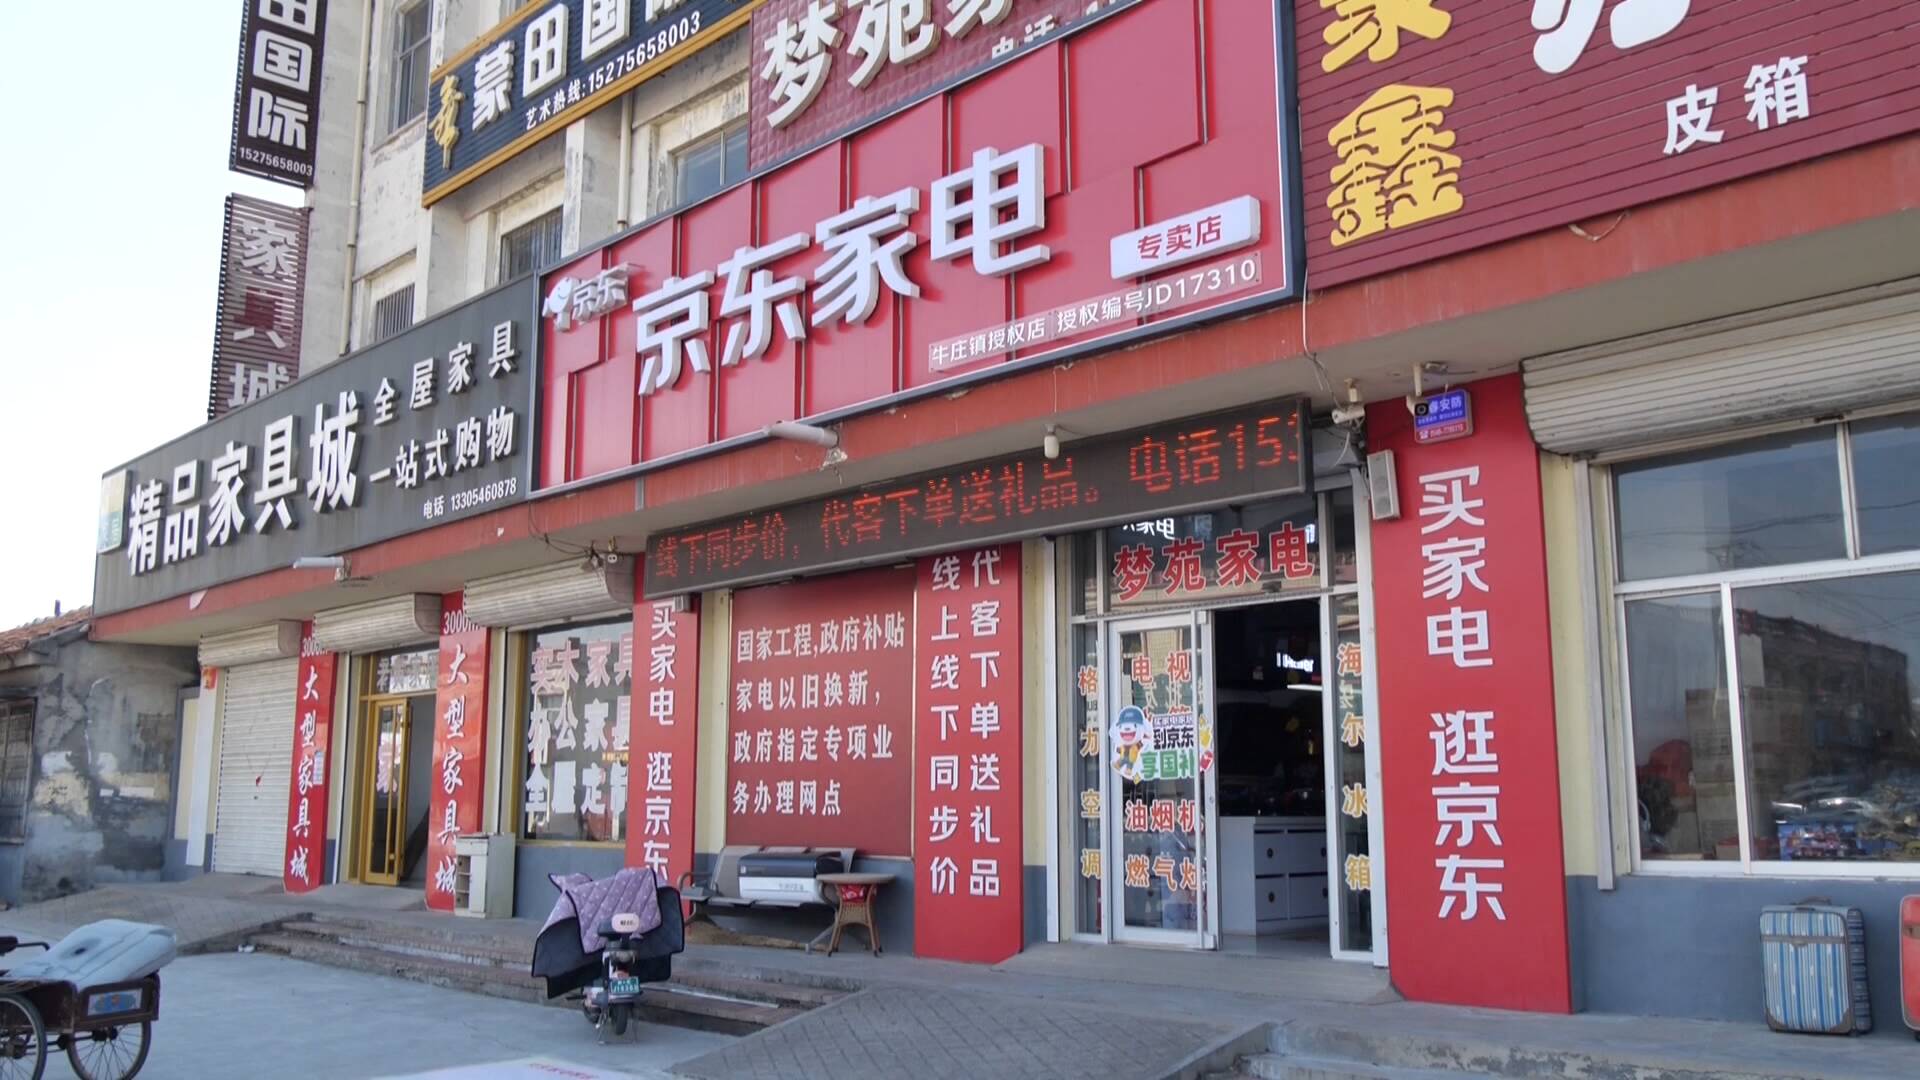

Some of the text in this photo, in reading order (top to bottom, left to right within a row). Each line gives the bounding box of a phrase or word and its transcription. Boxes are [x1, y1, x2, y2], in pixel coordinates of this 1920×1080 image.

[1662, 56, 1811, 156] 皮箱
[239, 147, 314, 177] 15275658003
[633, 143, 1051, 397] 京东家电
[1137, 215, 1222, 260] 专卖店
[226, 218, 300, 409] 家城
[572, 263, 629, 322] 京东
[932, 260, 1257, 364] 牛庄镇授权店 授权编号JD17310
[374, 320, 518, 426] 全屋家具
[128, 390, 360, 577] 精品家具城
[368, 406, 519, 490] 一站式购物
[423, 477, 517, 519] 电话 13305460878
[1113, 521, 1316, 601] 梦苑家电
[1418, 466, 1494, 668] 买家电
[1131, 650, 1192, 684] 电视
[290, 664, 320, 887] 大型家具城
[434, 643, 469, 895] 大型家具城
[643, 600, 677, 881] 买家电 逛京东
[733, 724, 894, 764] 政府指定专项业
[929, 556, 961, 896] 线上线下同步价
[968, 549, 1001, 897] 代客下单送礼品
[1078, 664, 1102, 881] 格力空调
[1153, 727, 1195, 750] 到京东
[1336, 641, 1371, 892] 海尔冰箱
[732, 779, 842, 817] 务办理网点
[1125, 799, 1198, 833] 油烟机
[1429, 710, 1507, 921] 逛京东
